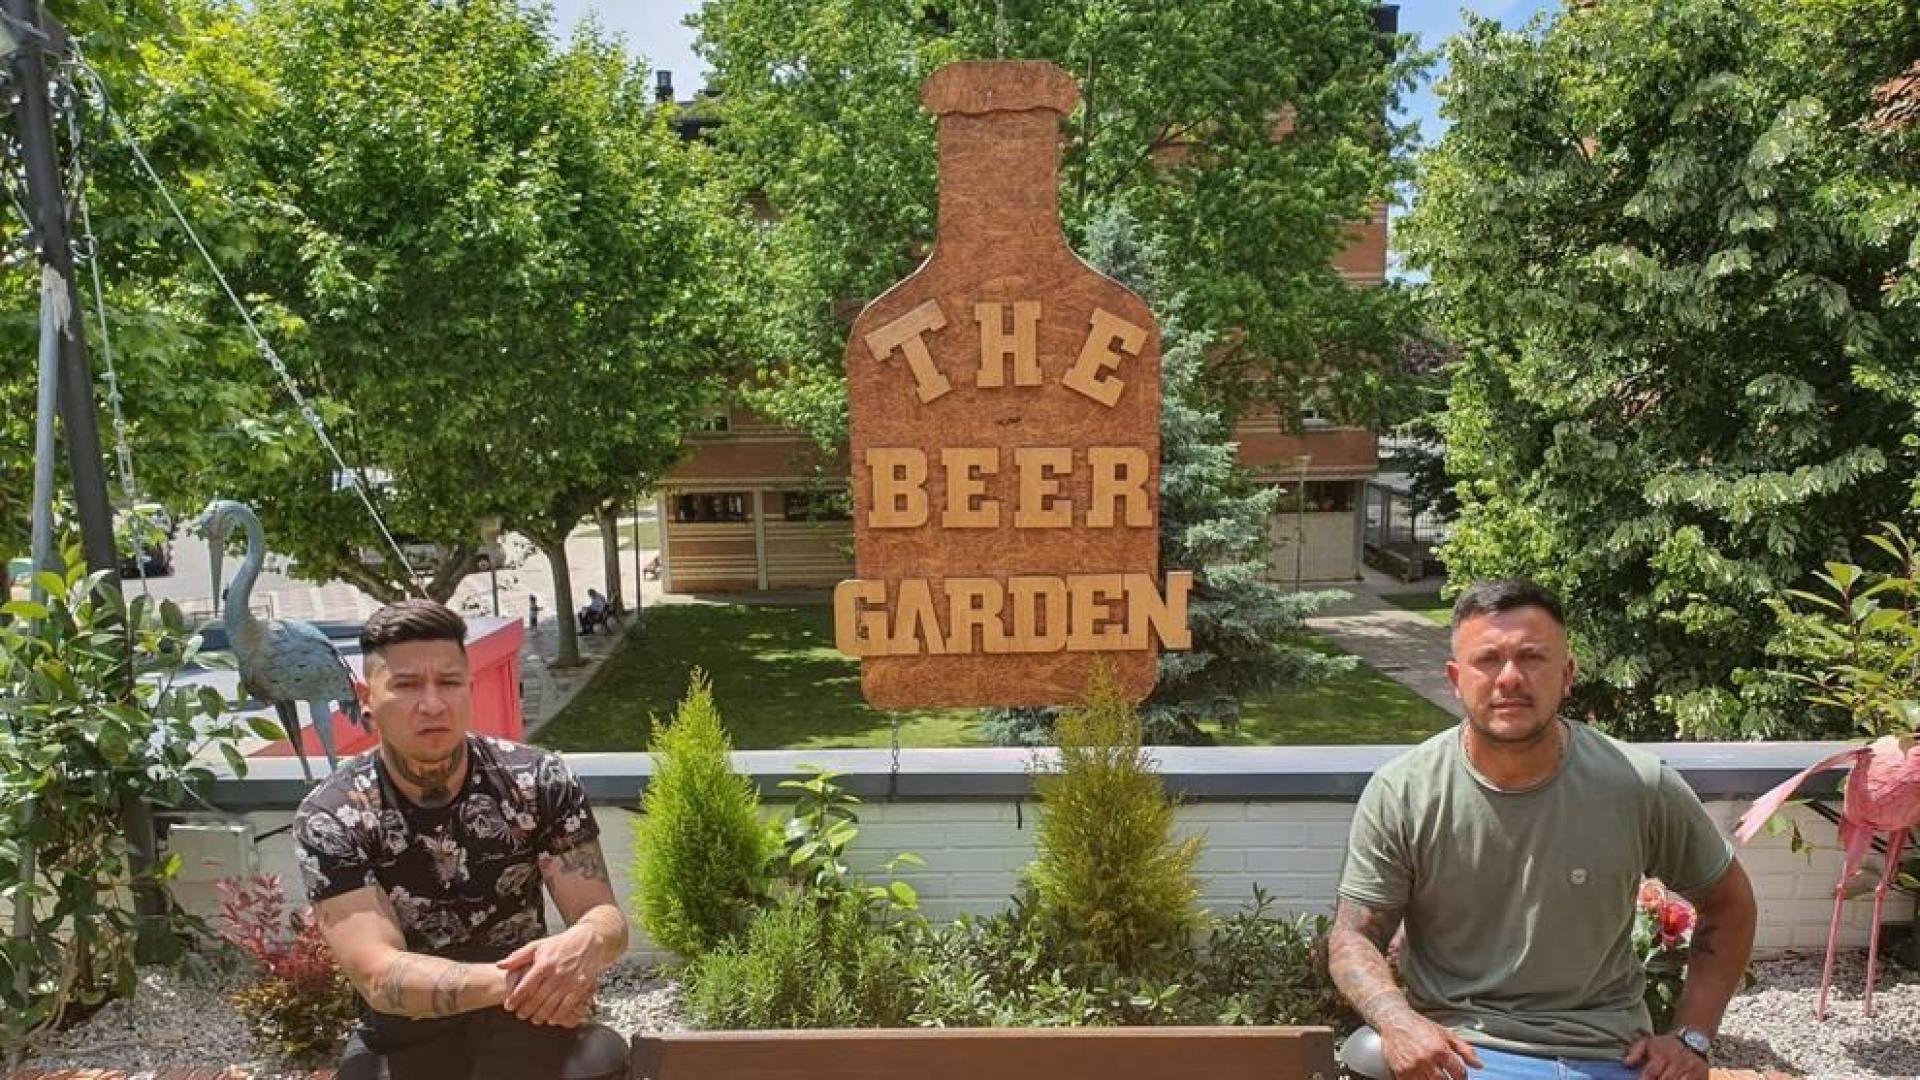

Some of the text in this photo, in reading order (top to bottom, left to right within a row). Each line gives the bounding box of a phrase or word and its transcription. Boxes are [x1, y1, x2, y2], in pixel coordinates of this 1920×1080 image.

[865, 299, 1149, 407] THE
[866, 447, 1152, 528] BEER
[834, 571, 1193, 655] GARDEN
